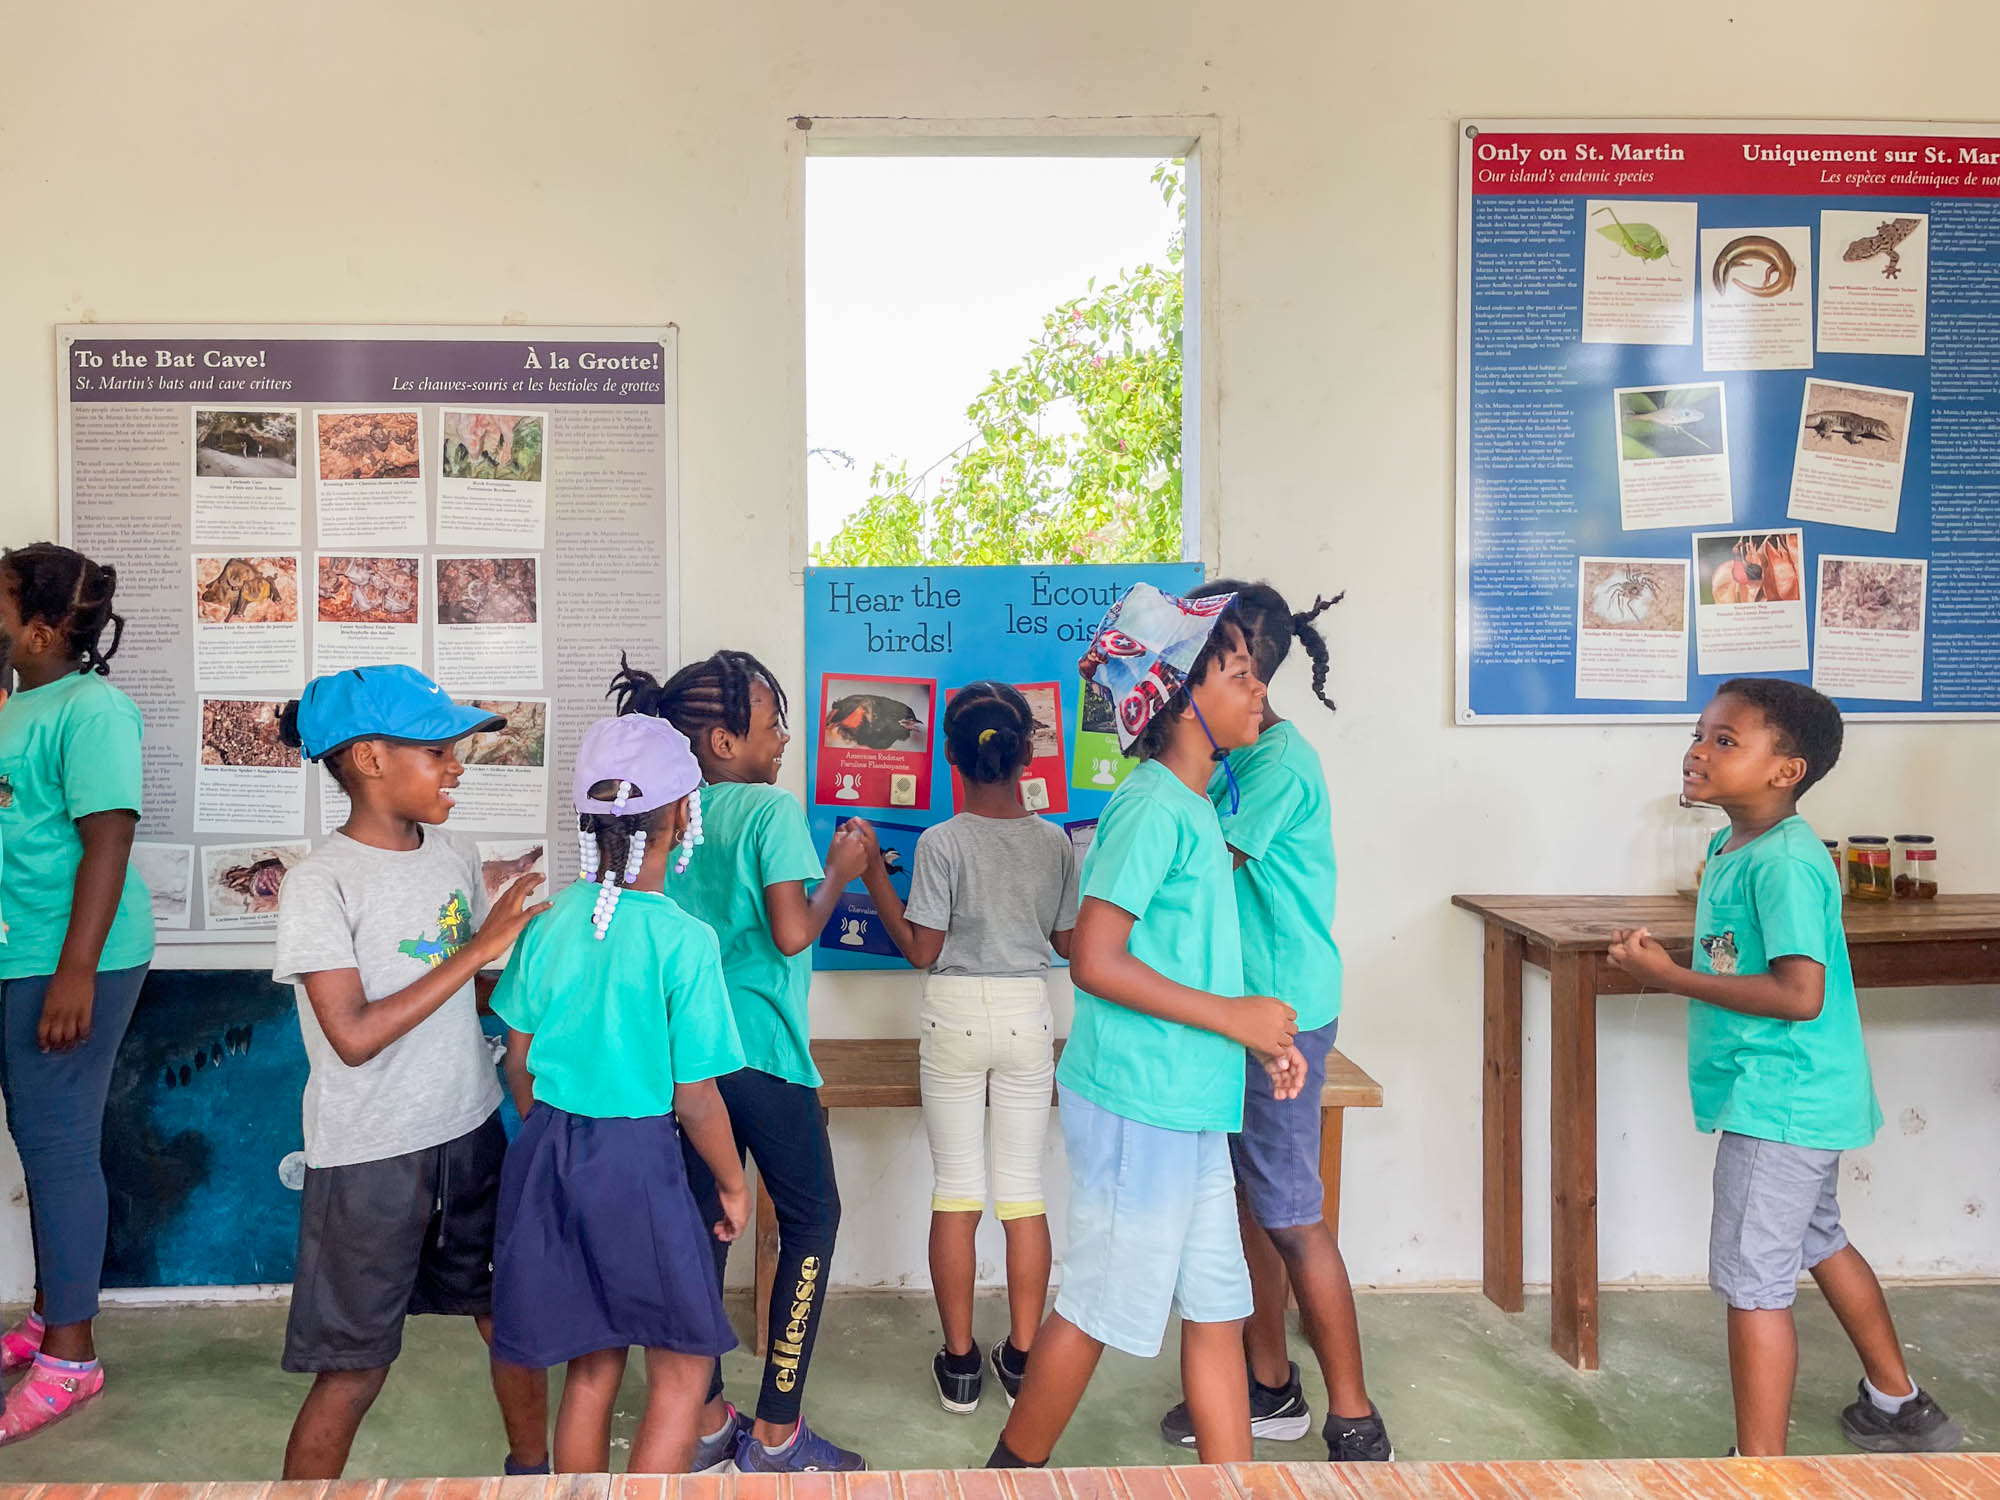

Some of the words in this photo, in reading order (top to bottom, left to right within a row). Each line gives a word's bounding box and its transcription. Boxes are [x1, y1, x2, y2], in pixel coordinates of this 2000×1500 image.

[1478, 143, 1532, 165] Only
[1539, 149, 1567, 161] on
[1575, 143, 1604, 161] St.
[1610, 143, 1685, 161] Martin
[1742, 144, 1878, 166] Uniquement
[1885, 149, 1917, 163] sur
[1924, 147, 1953, 164] St.
[1958, 148, 2000, 165] Mar
[1478, 169, 1506, 182] Our
[1559, 168, 1610, 182] endemic
[1613, 169, 1655, 186] species
[1820, 170, 1841, 183] Les
[1845, 169, 1886, 187] espèces
[1890, 170, 1960, 188] endémiques
[1963, 171, 1978, 185] de
[75, 350, 104, 368] To
[112, 350, 148, 368] the
[155, 350, 195, 368] Bat
[203, 350, 267, 368] Cave!
[523, 346, 542, 369] À
[549, 352, 570, 369] la
[578, 352, 659, 370] Grotte!
[76, 376, 94, 390] St.
[159, 376, 184, 390] bats
[189, 376, 214, 390] and
[218, 380, 246, 390] cave
[250, 376, 293, 390] critters
[392, 377, 414, 391] Les
[418, 376, 508, 391] chauves-souris
[512, 379, 524, 391] et
[528, 376, 544, 391] les
[548, 376, 598, 392] bestioles
[603, 376, 617, 392] de
[619, 380, 660, 395] grottes
[828, 581, 904, 615] Hear
[911, 576, 961, 610] the
[1030, 571, 1127, 606] Écout
[1005, 603, 1048, 634] les
[864, 620, 953, 653] birds!
[845, 751, 877, 760] American
[878, 753, 905, 762] Redstart
[771, 1255, 820, 1393] ellesse
